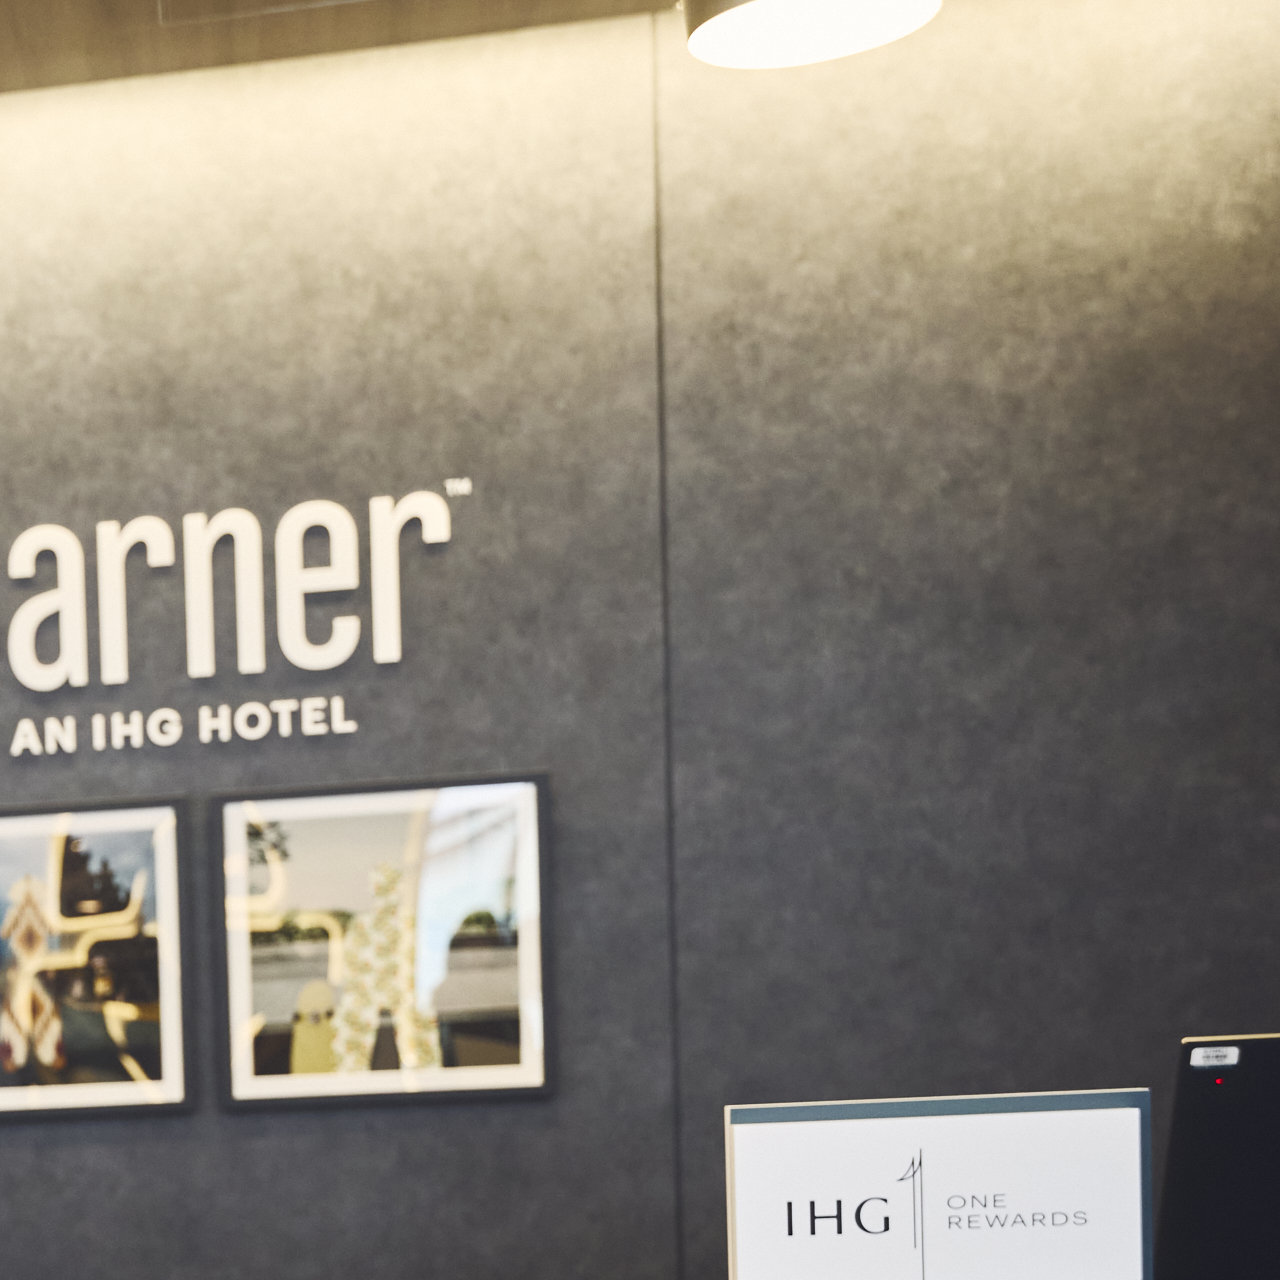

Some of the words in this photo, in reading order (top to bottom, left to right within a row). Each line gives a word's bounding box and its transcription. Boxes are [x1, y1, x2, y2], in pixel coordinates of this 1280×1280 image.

[10, 718, 77, 757] AN
[91, 708, 183, 751] IHG
[198, 696, 358, 744] HOTEL
[946, 1193, 1007, 1210] ONE
[786, 1197, 890, 1236] IHG
[947, 1210, 1089, 1229] REWARDS
